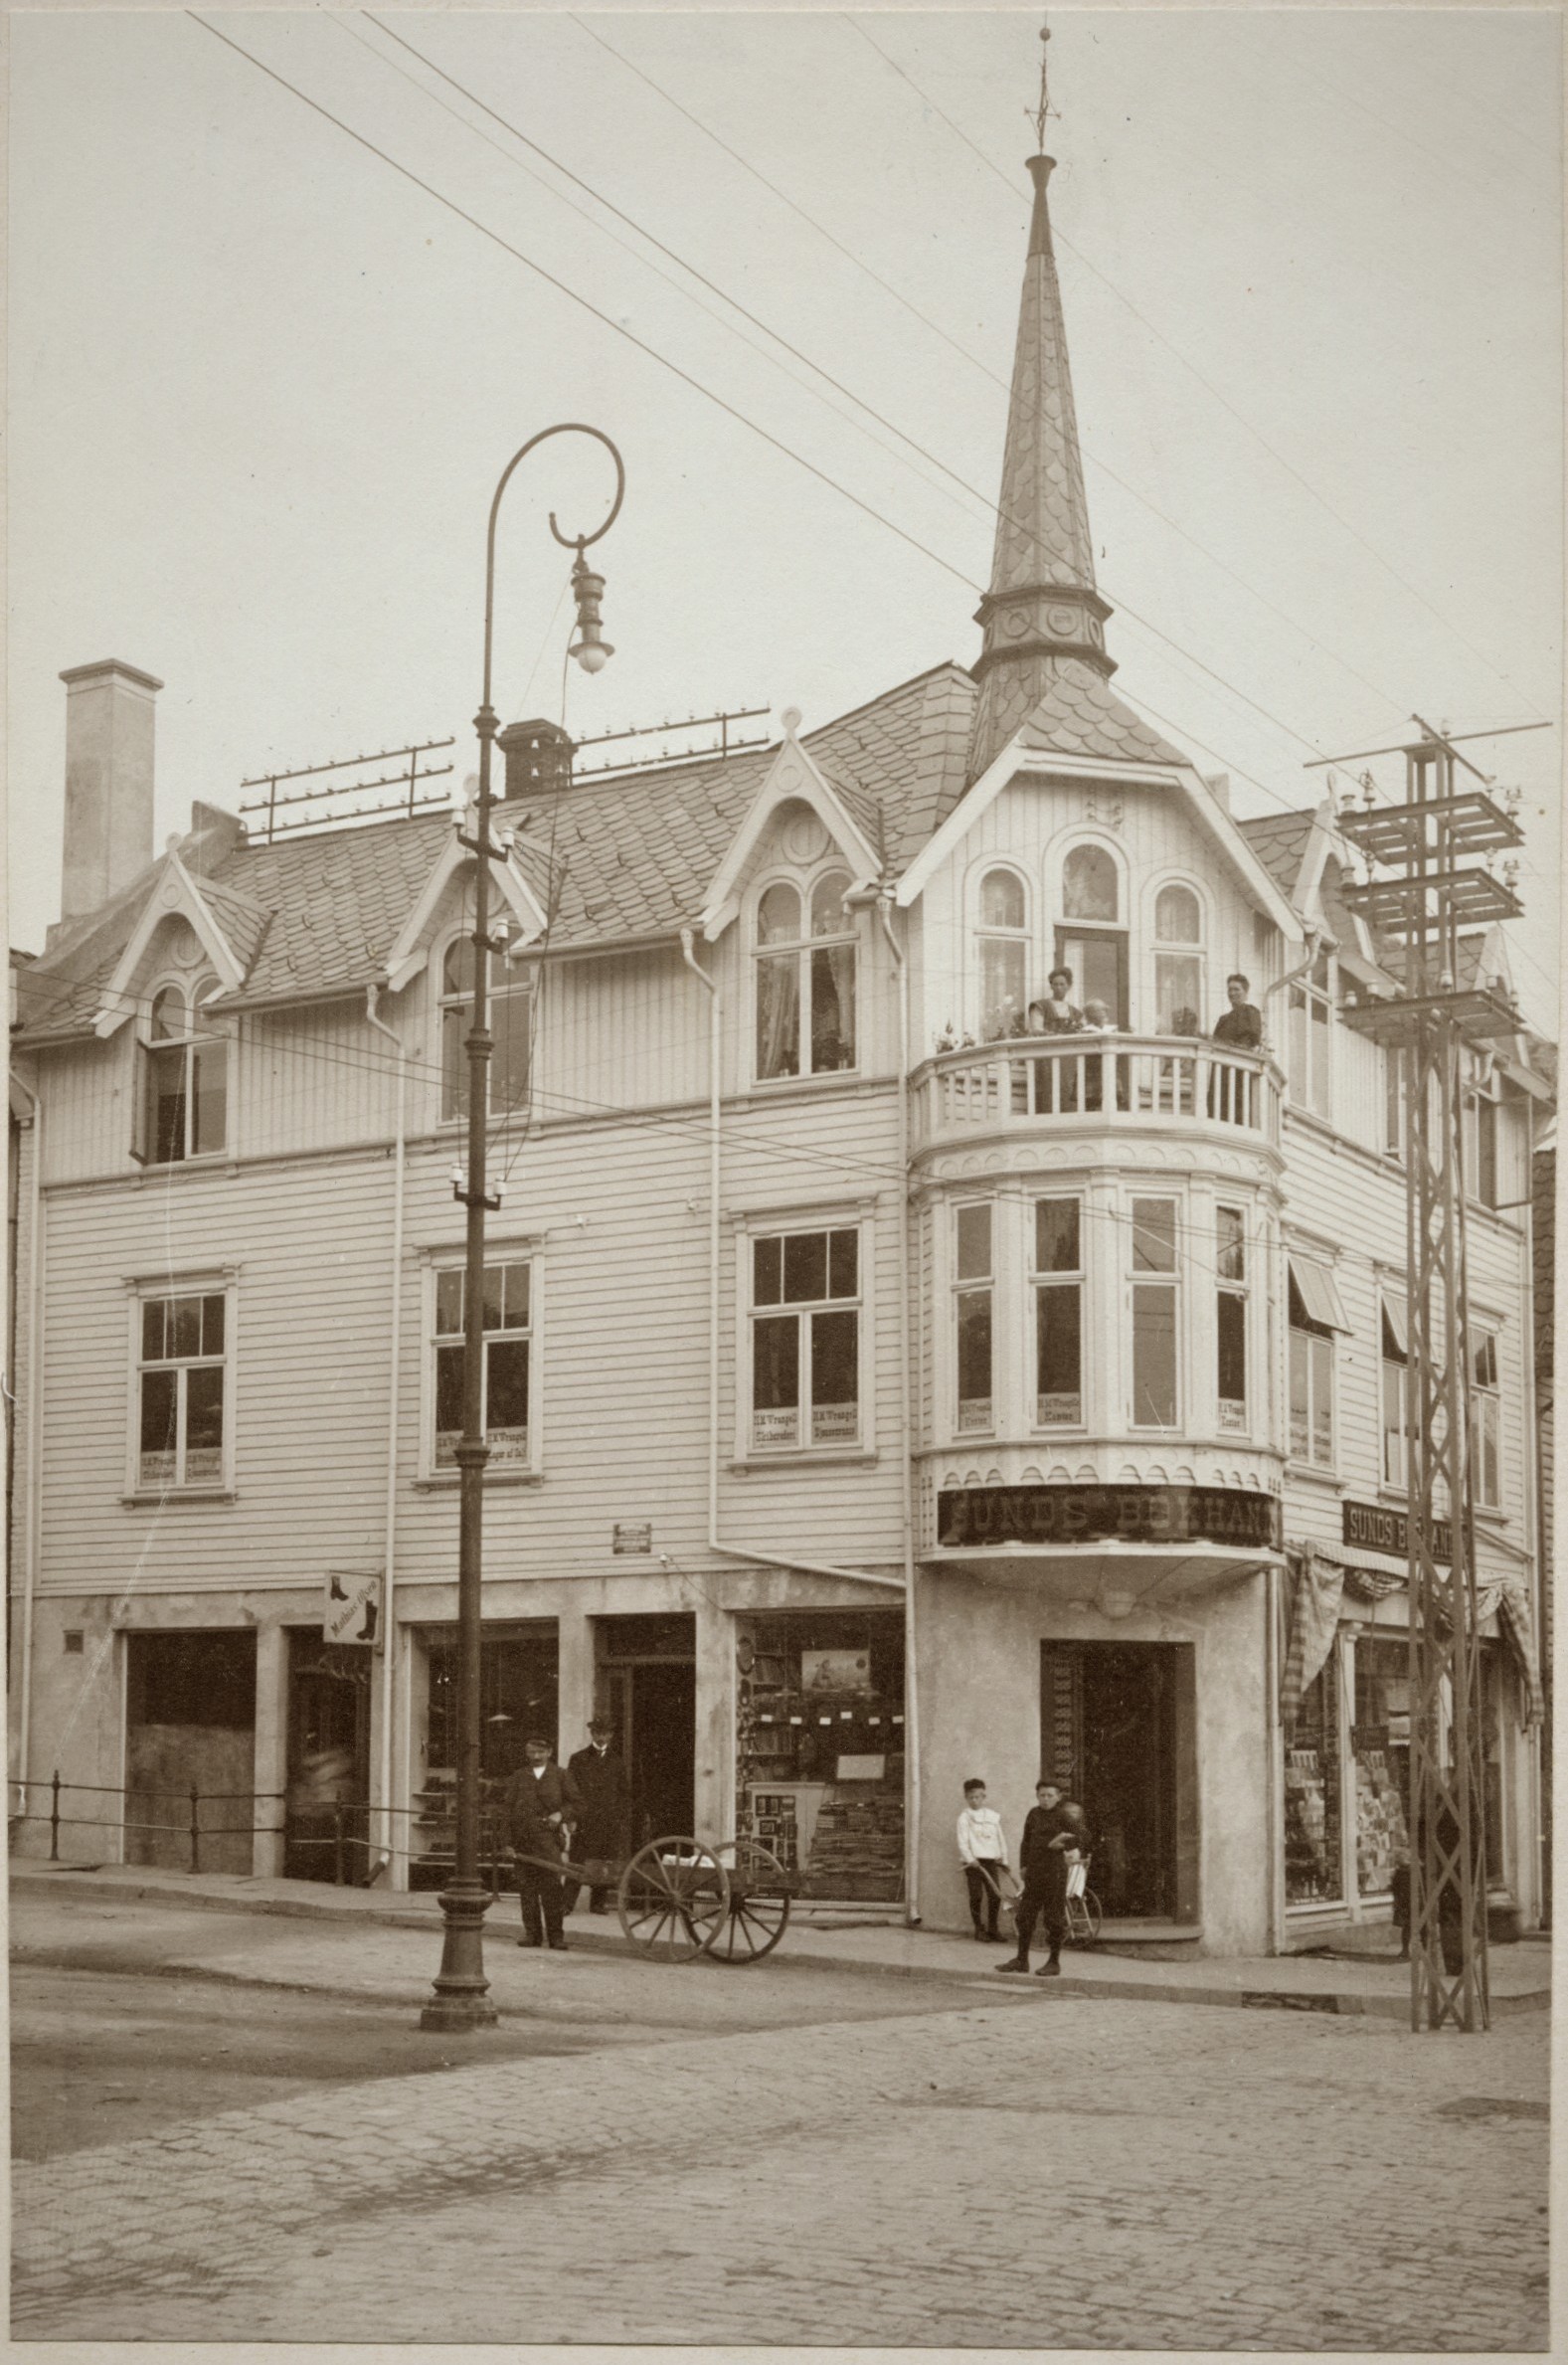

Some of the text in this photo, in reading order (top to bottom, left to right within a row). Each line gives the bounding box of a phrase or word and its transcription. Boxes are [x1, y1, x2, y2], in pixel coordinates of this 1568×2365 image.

[952, 1494, 1088, 1533] SUNDS
[1349, 1509, 1392, 1546] SUNDS
[357, 1579, 377, 1605] Olsen
